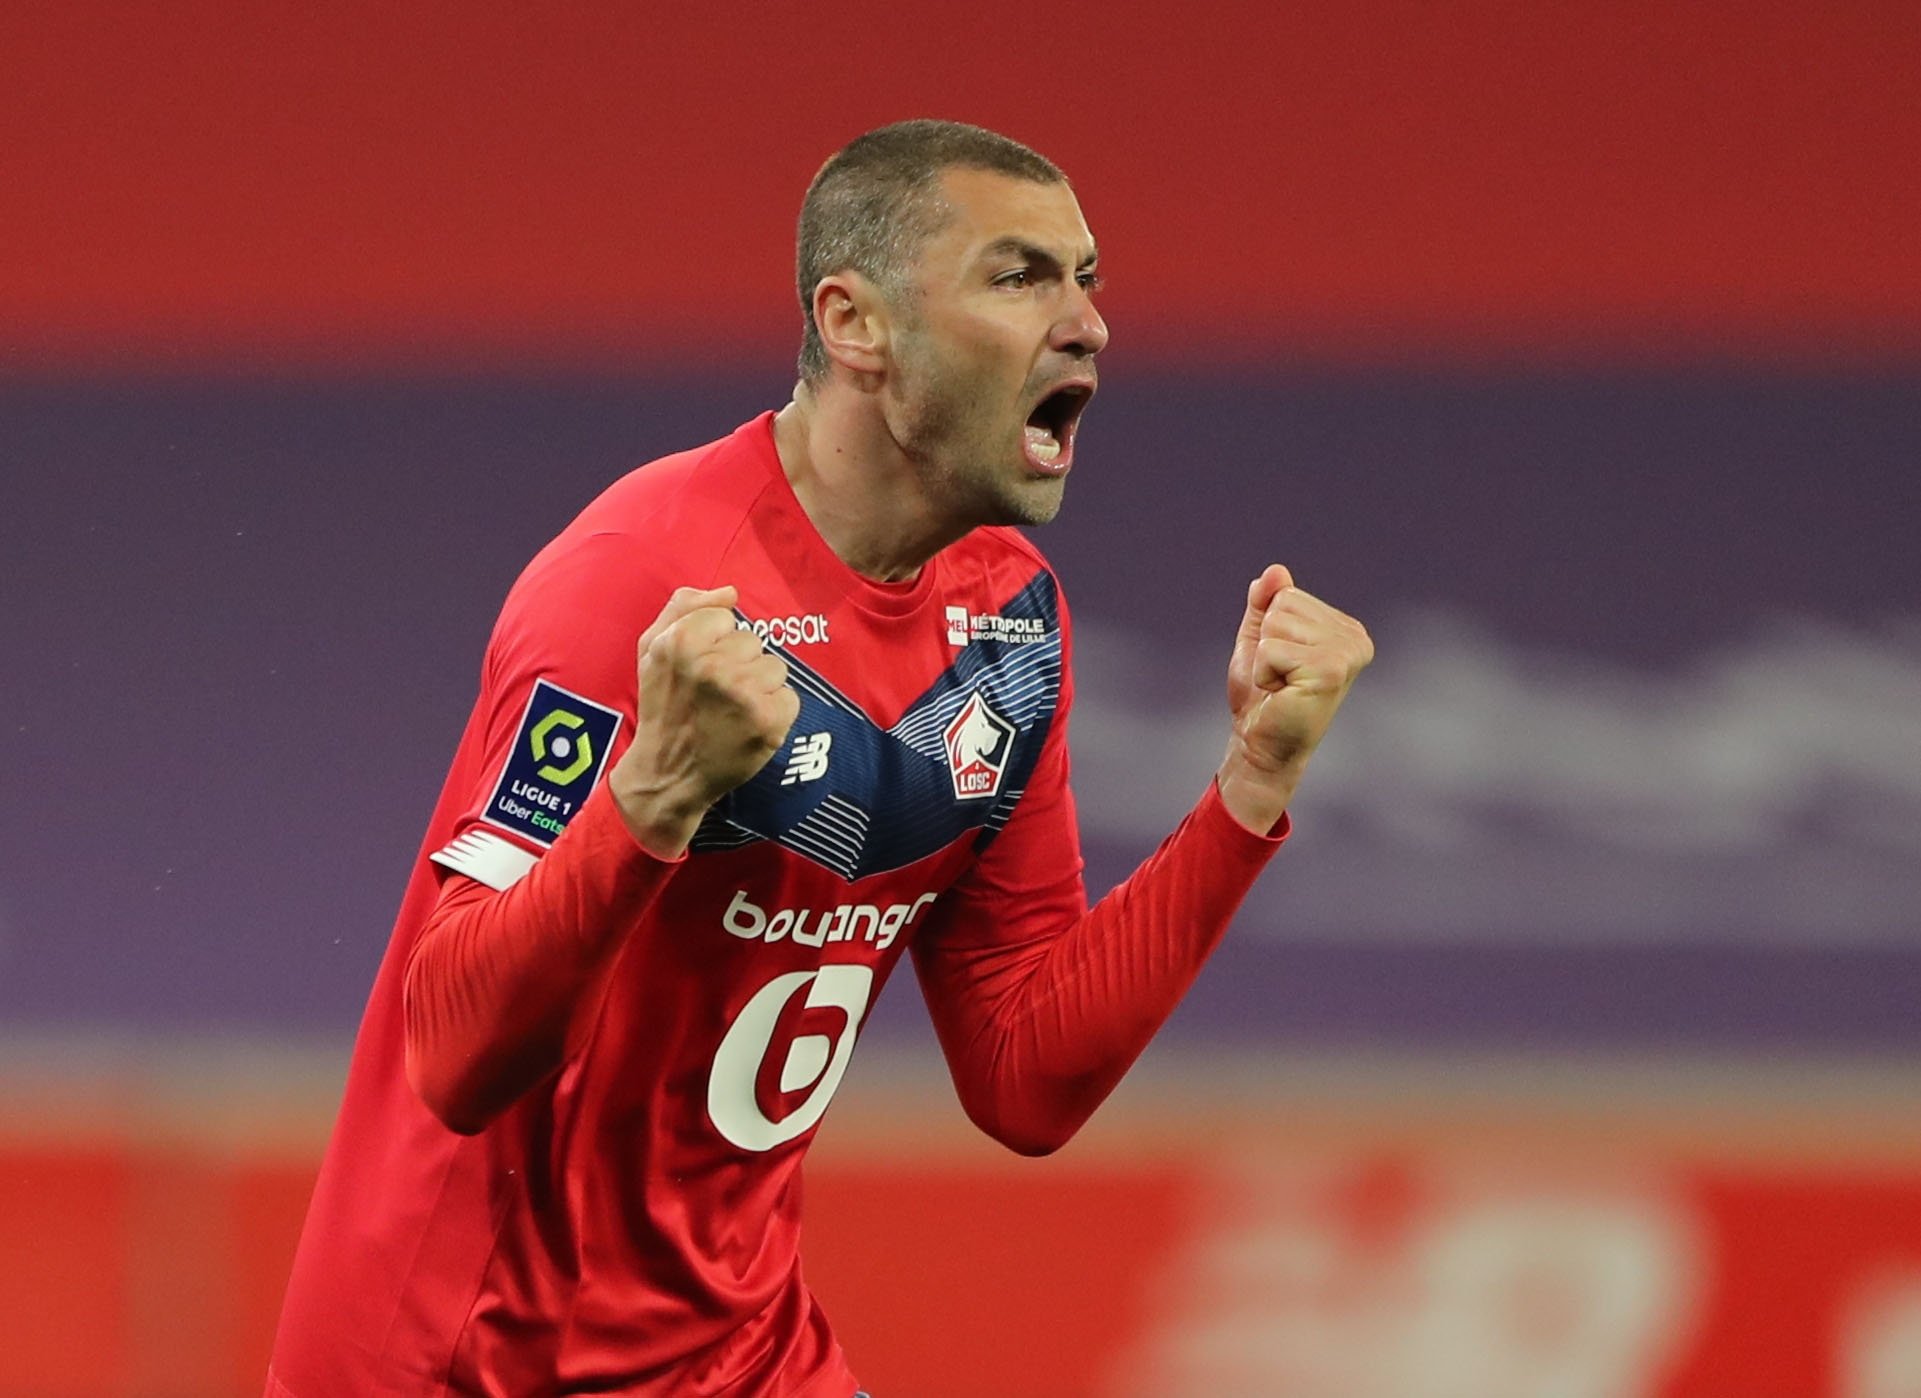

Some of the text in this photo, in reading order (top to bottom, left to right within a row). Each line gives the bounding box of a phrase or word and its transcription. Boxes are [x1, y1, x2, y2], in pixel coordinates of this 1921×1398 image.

[970, 612, 1045, 634] MÉTOPOLE
[960, 771, 991, 792] LOSC
[511, 780, 572, 815] LIGUE 1
[498, 796, 565, 835] Uber Eats
